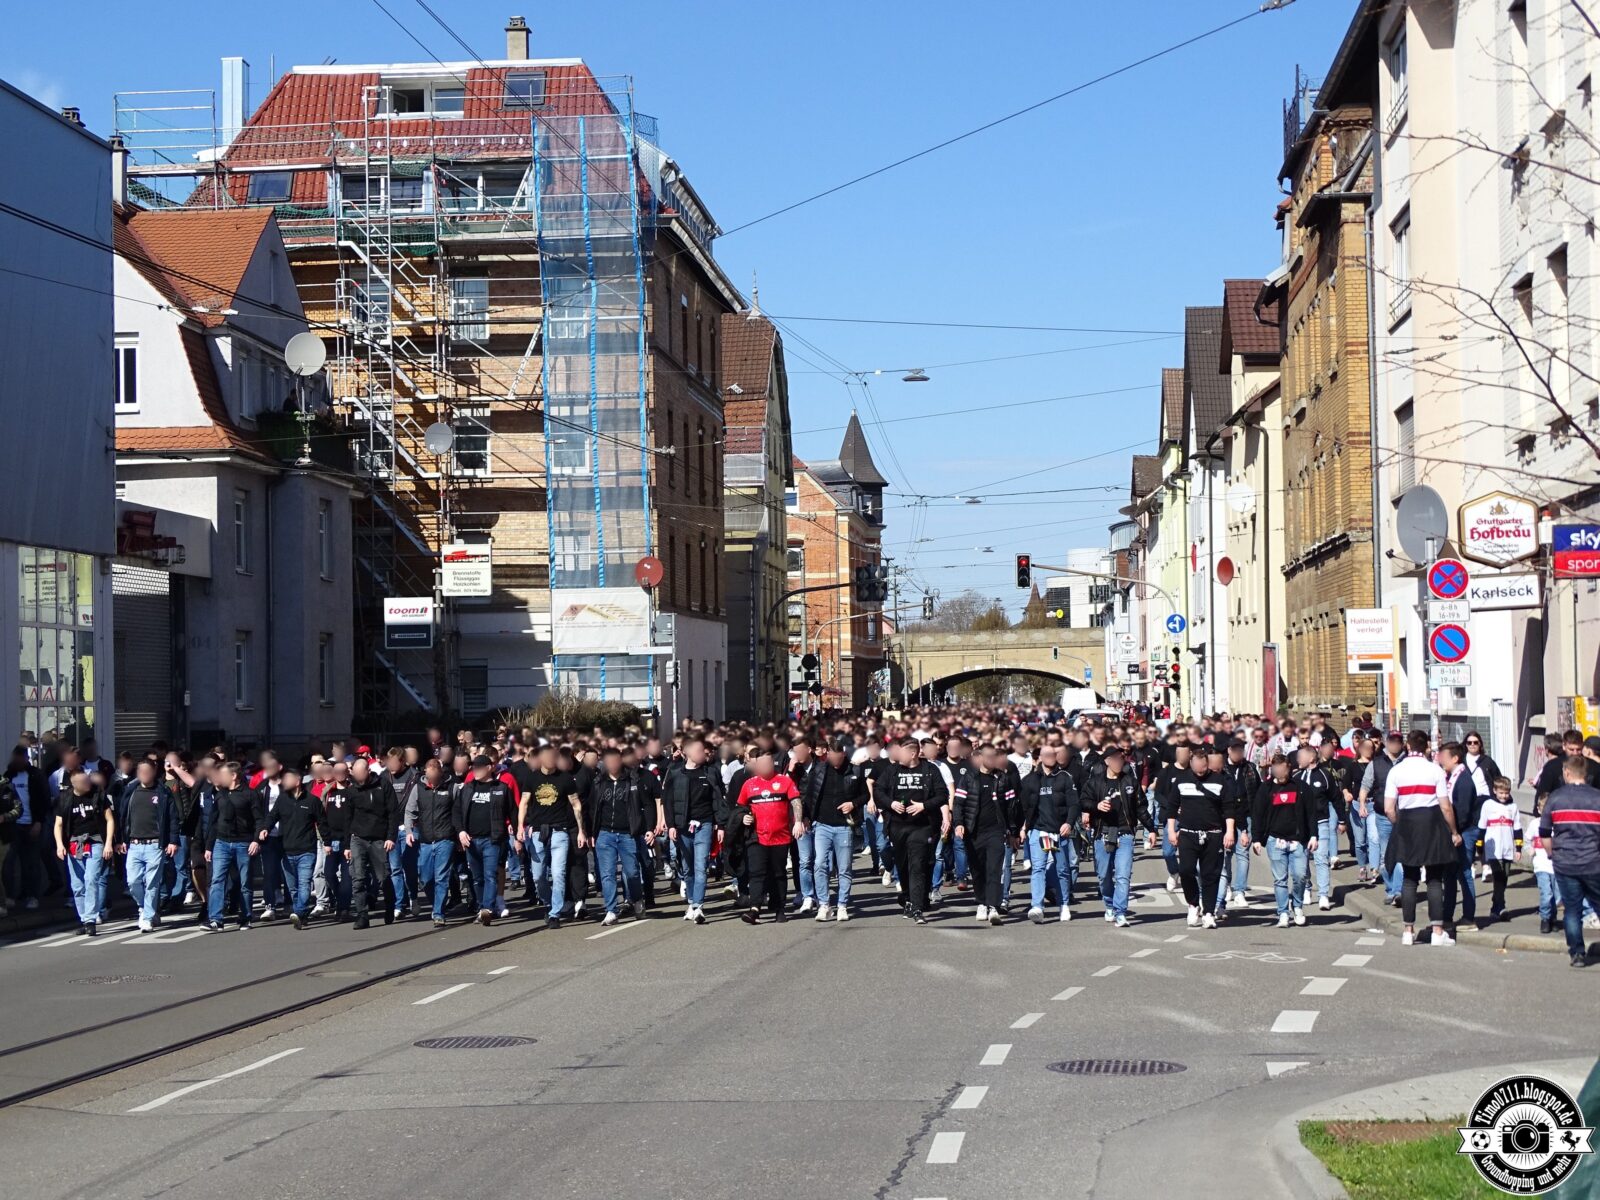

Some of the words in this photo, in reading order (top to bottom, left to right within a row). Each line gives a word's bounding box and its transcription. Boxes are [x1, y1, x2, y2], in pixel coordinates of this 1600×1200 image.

[1470, 525, 1531, 541] Hofbräu
[1569, 529, 1600, 550] sky
[1471, 585, 1534, 599] Karlseck
[1356, 626, 1383, 634] verlegt
